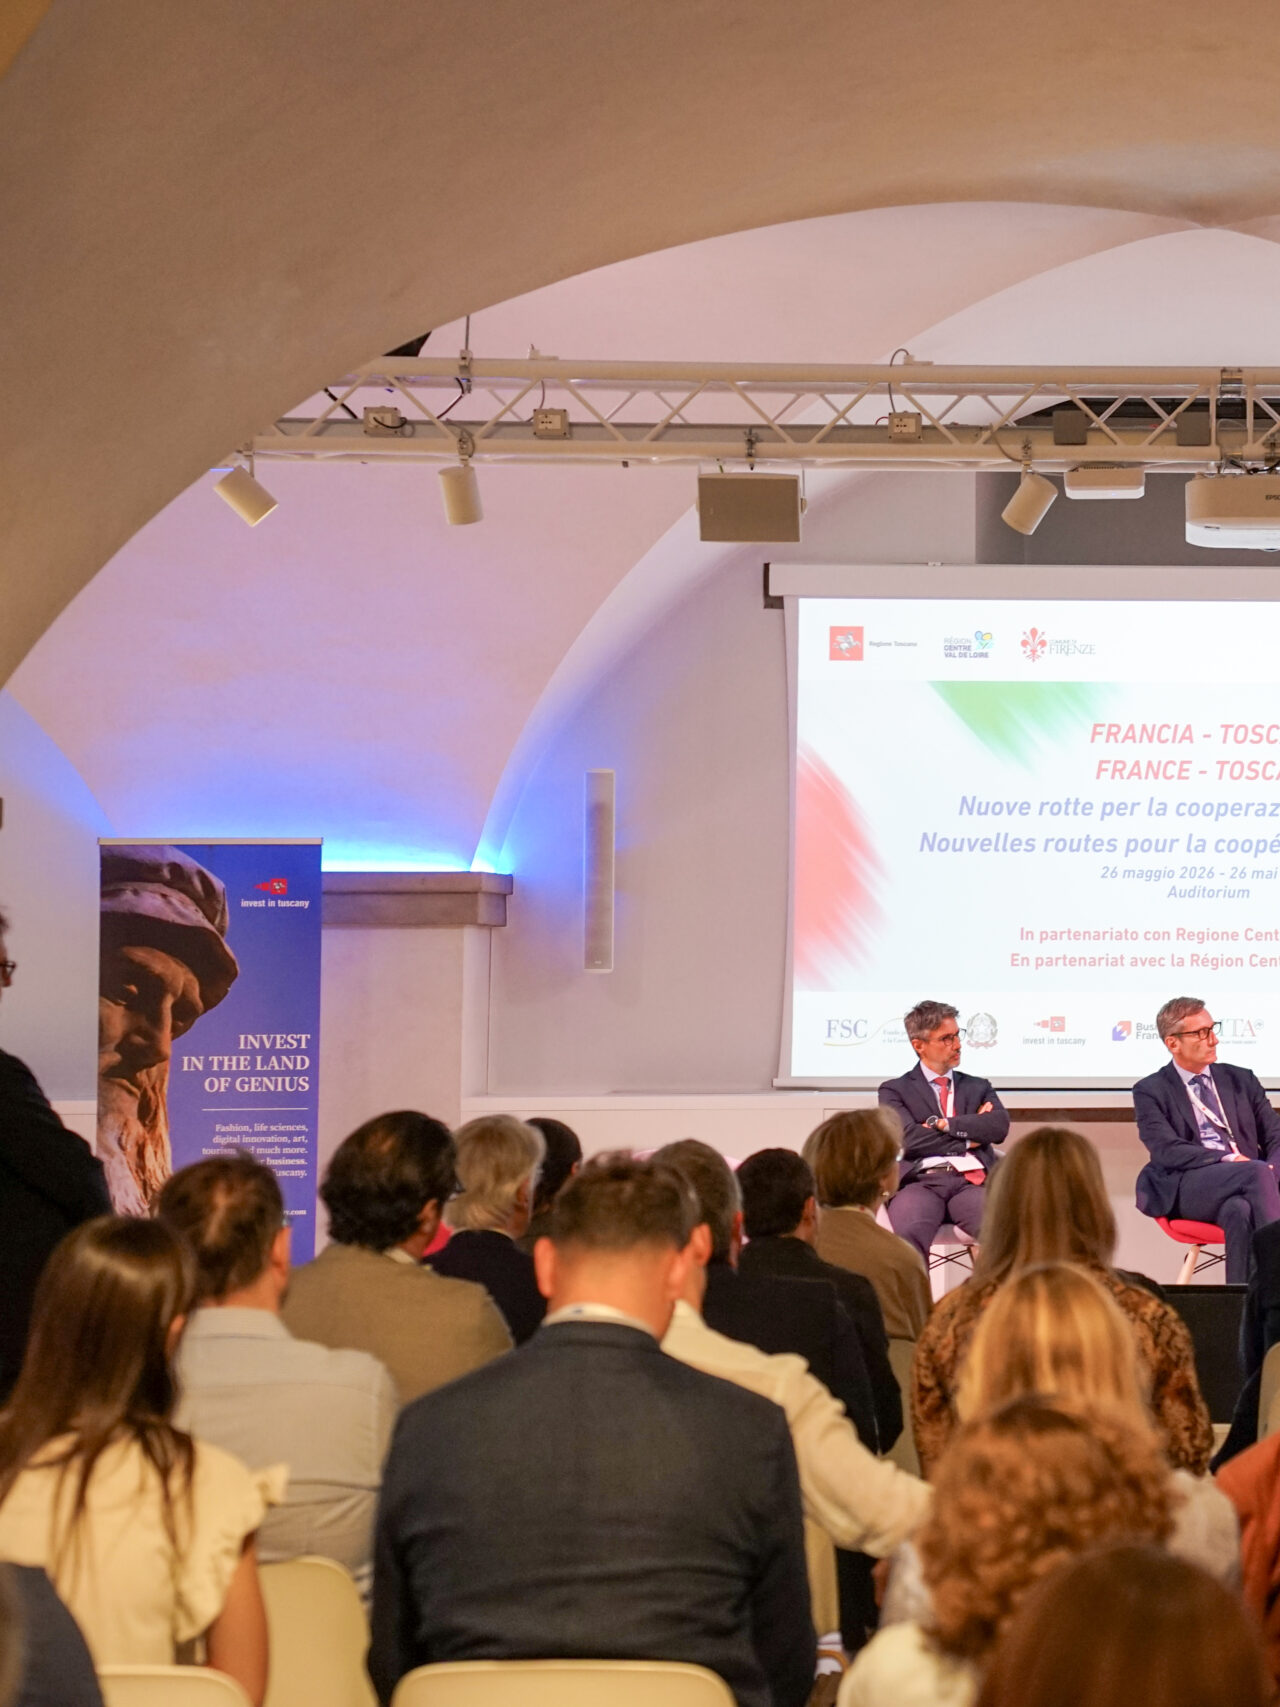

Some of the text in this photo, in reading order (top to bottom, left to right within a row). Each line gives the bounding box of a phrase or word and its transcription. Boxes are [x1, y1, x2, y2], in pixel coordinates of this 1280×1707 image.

[1049, 644, 1096, 656] FIRENZE
[1089, 722, 1195, 745] FRANCIA
[1095, 759, 1193, 781] FRANCE
[957, 795, 1032, 817] Nuove
[1037, 797, 1094, 817] rotte
[1099, 801, 1142, 822] per
[1147, 796, 1168, 817] la
[918, 831, 1037, 854] Nouvelles
[1042, 833, 1119, 854] routes
[1123, 837, 1181, 859] pour
[1185, 832, 1207, 854] la
[1100, 865, 1119, 879] 26
[1121, 865, 1176, 883] maggio
[1178, 865, 1216, 880] 2026
[1228, 866, 1247, 880] 26
[1250, 866, 1279, 880] mai
[1166, 884, 1251, 899] Auditorium
[240, 898, 310, 909] invest in tuscany
[1019, 926, 1035, 941] In
[1039, 927, 1140, 945] partenariato
[1143, 930, 1171, 942] con
[1175, 927, 1240, 945] Regione
[1010, 952, 1031, 968] En
[1034, 952, 1126, 971] partenariat
[1129, 956, 1166, 968] avec
[1170, 952, 1185, 968] la
[1189, 952, 1244, 971] Région
[826, 1019, 868, 1039] FSC
[1136, 1031, 1159, 1040] Fran
[237, 1033, 311, 1050] INVEST
[1022, 1036, 1086, 1046] invest in tuscany
[182, 1055, 310, 1072] IN THE LAND
[204, 1076, 310, 1093] OF GENIUS
[216, 1123, 308, 1132] Fashion, life sciences,
[213, 1135, 240, 1145] digital
[242, 1135, 290, 1143] innovation,
[256, 1146, 280, 1154] much
[266, 1157, 307, 1165] business.
